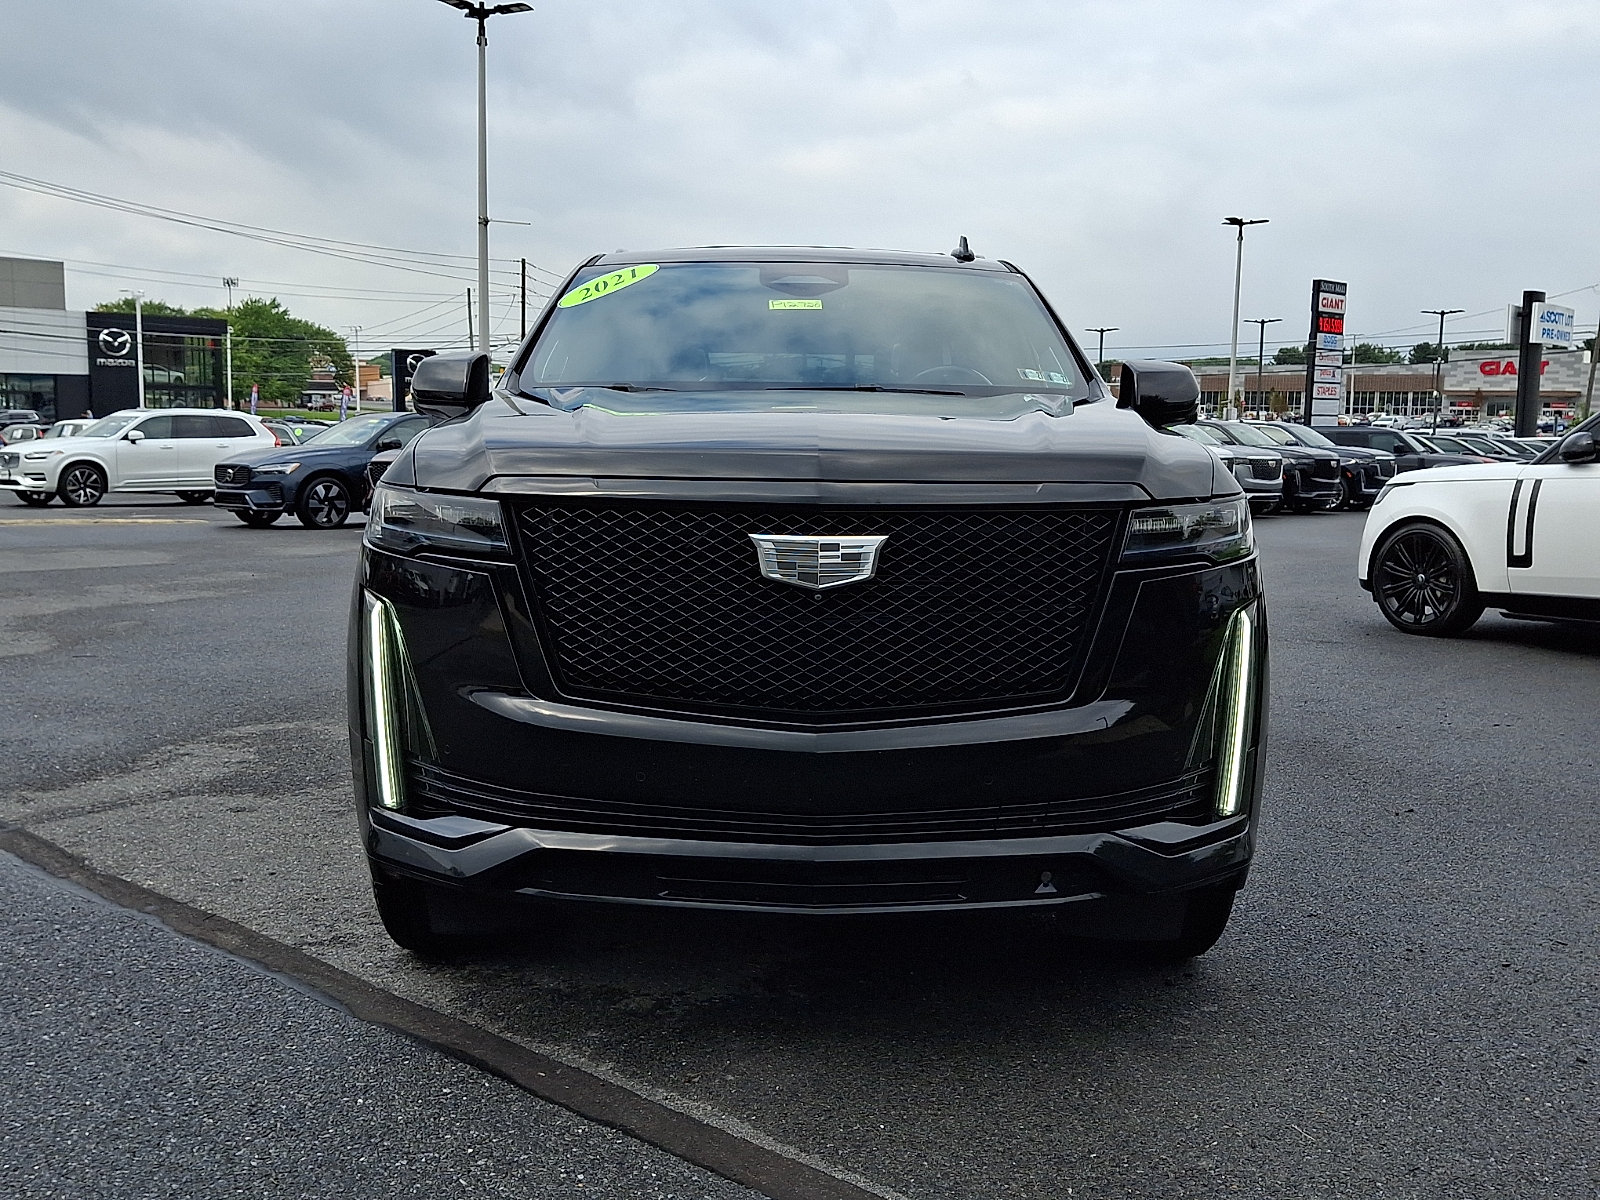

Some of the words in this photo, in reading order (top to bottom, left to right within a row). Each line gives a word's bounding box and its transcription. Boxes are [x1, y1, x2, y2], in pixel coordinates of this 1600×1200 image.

[579, 268, 637, 301] 2021
[1321, 297, 1344, 310] GIANT
[1541, 327, 1571, 342] PRE-OWNED
[1480, 361, 1550, 375] GIAT
[1317, 386, 1337, 396] STAPLES
